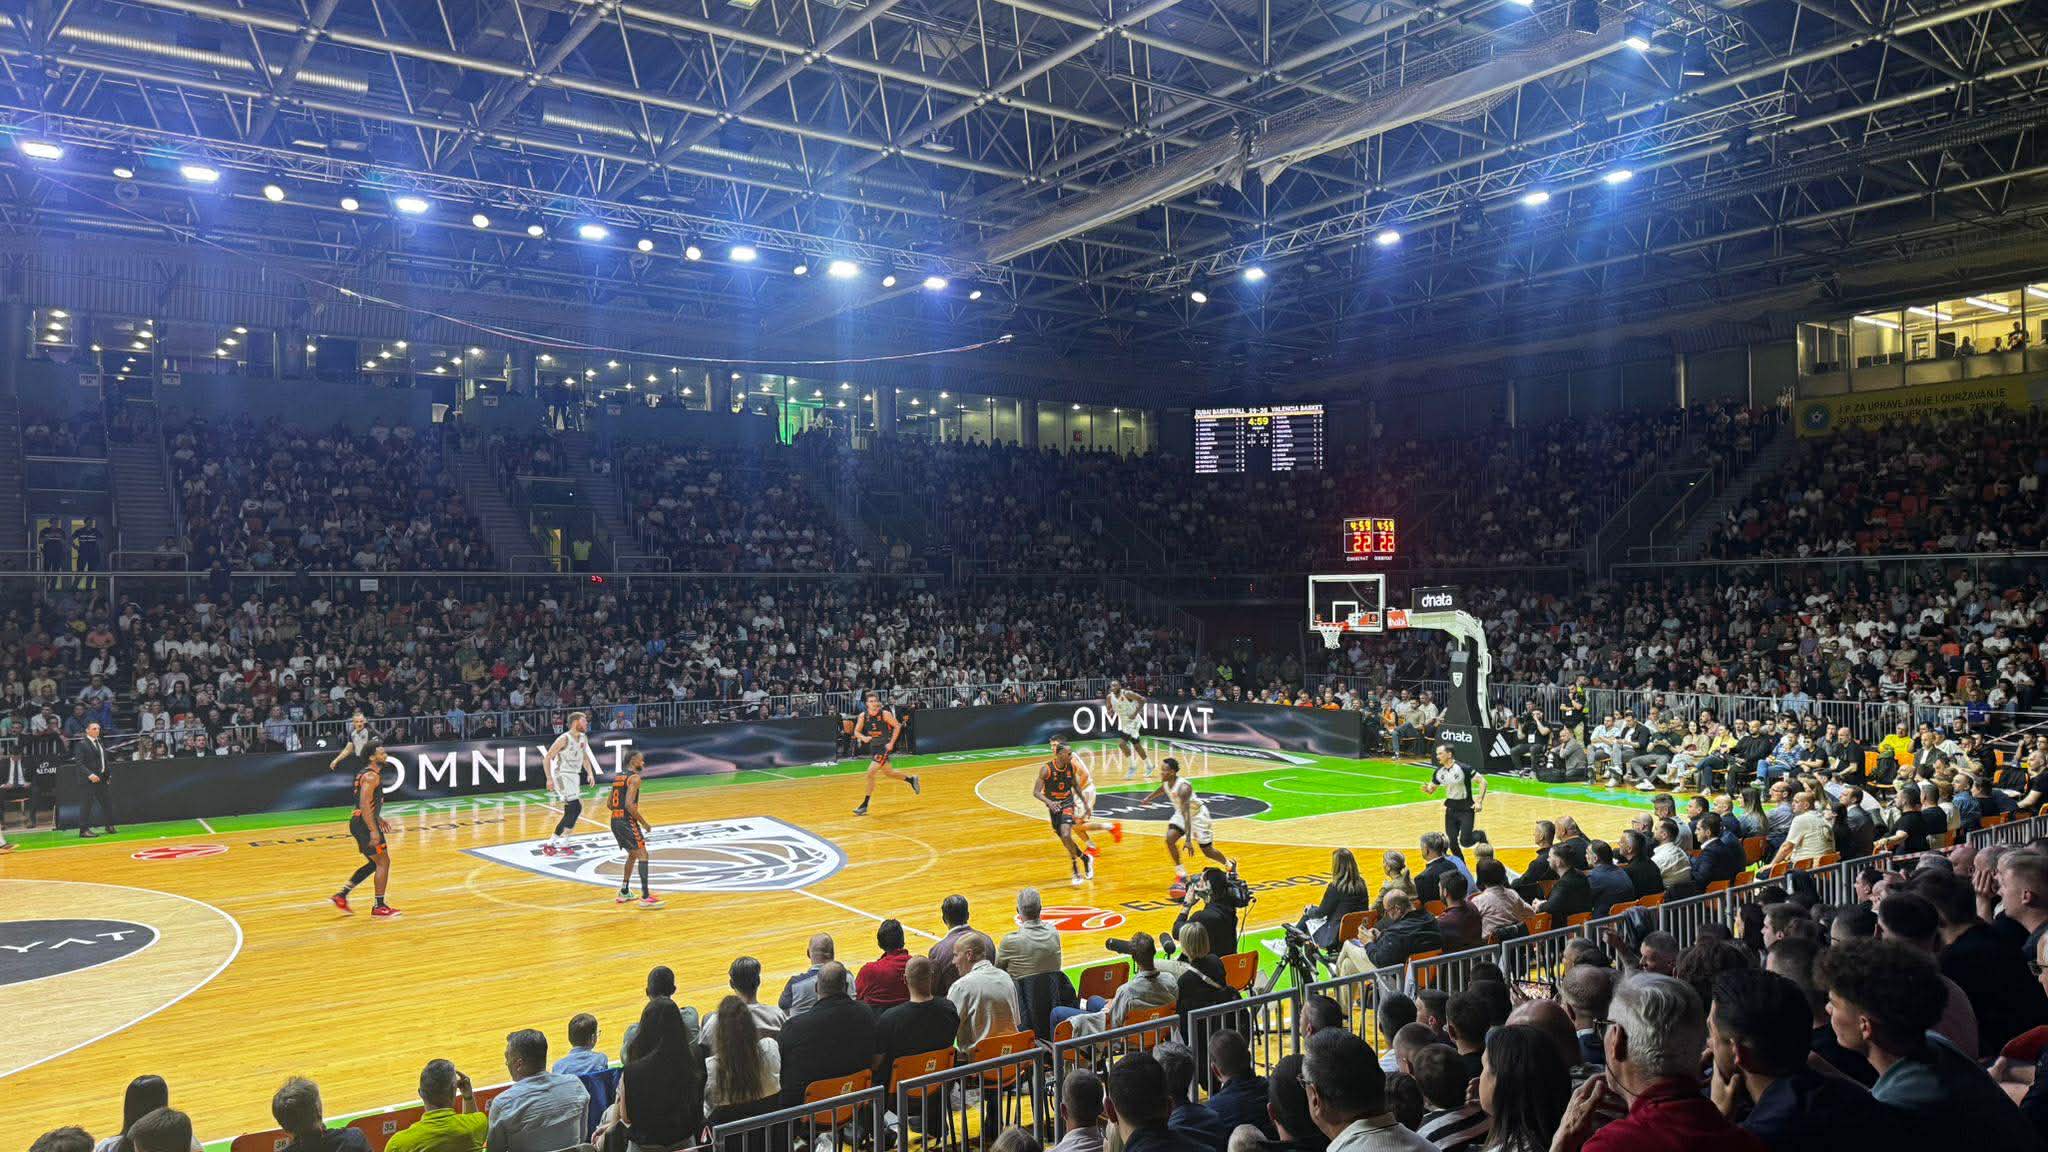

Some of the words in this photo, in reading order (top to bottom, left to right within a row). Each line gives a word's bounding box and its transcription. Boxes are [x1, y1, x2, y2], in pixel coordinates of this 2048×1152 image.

[1248, 417, 1269, 426] 4:59
[1354, 535, 1371, 552] 22
[1380, 535, 1394, 552] 22
[1421, 593, 1452, 607] dnata
[1073, 703, 1214, 735] OMNIYAT
[1441, 729, 1472, 742] dnata
[612, 789, 620, 808] 8
[249, 818, 504, 849] Euroeague
[1120, 871, 1333, 911] Eueagu
